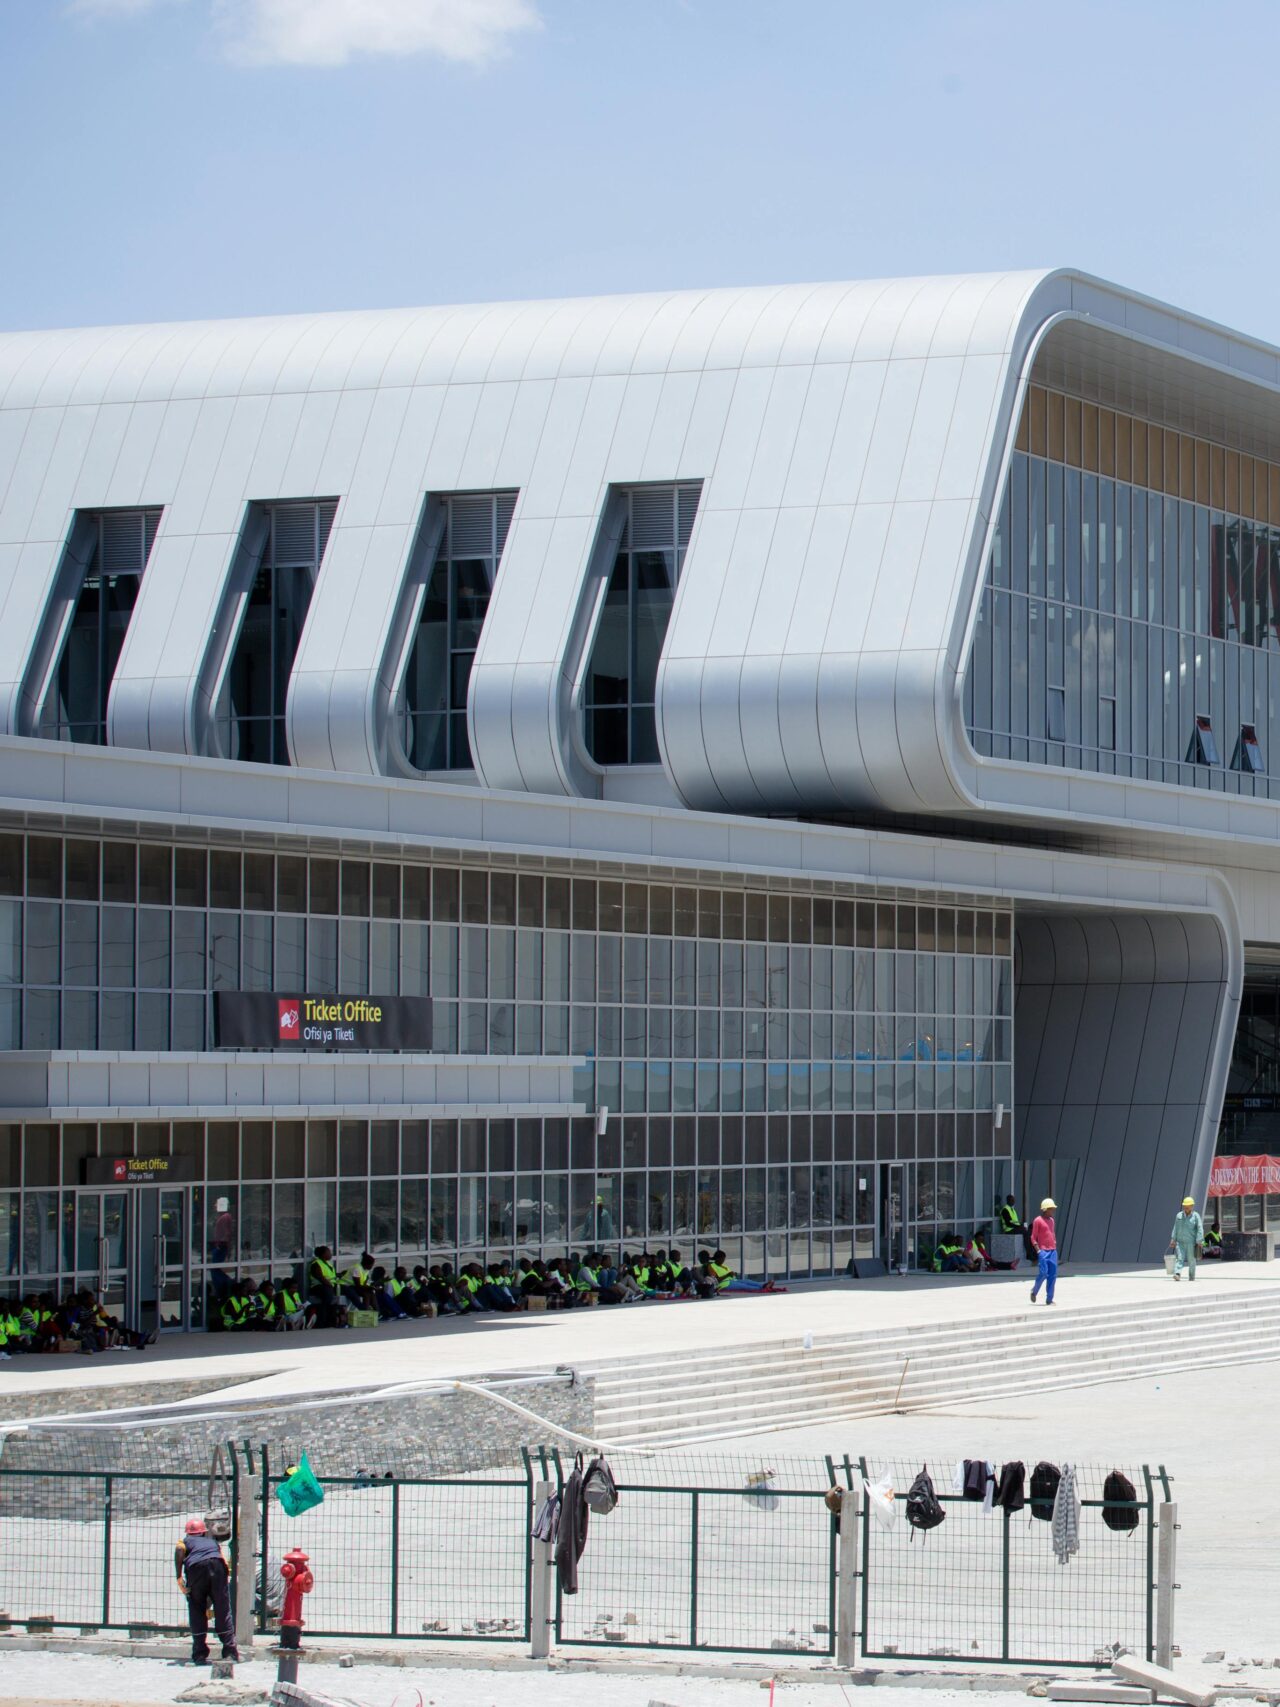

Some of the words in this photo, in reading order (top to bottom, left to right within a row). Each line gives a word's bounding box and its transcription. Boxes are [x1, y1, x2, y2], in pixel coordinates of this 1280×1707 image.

[304, 999, 342, 1021] Ticket
[344, 1000, 382, 1022] Office
[303, 1027, 321, 1040] Ofisi
[323, 1030, 332, 1043] ya
[334, 1027, 354, 1041] Tiketi
[128, 1160, 148, 1170] Ticket
[148, 1158, 168, 1170] Office
[1248, 1166, 1259, 1183] THE
